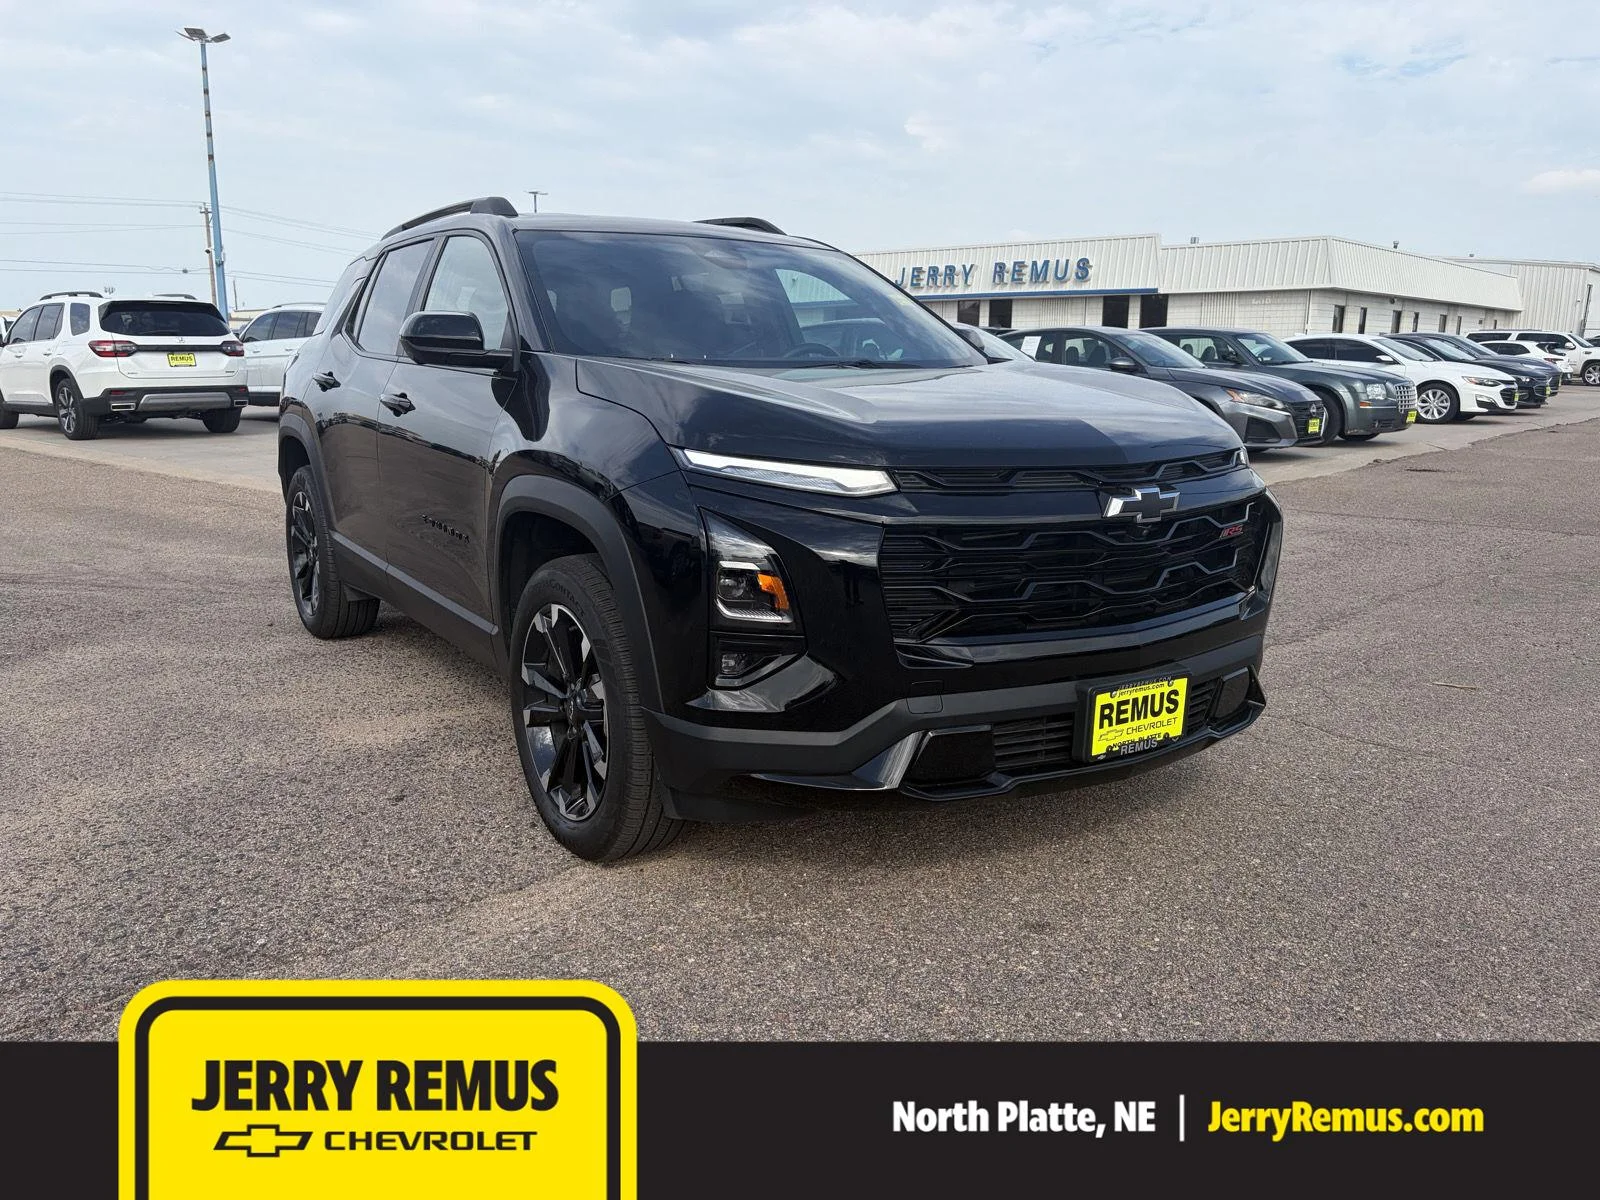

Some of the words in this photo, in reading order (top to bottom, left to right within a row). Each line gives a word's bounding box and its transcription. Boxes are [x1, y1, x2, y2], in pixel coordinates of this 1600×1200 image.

[895, 263, 974, 288] JERRY
[992, 257, 1091, 284] REMUS
[1118, 683, 1165, 698] jerryremus.com
[1098, 689, 1180, 730] REMUS
[1126, 717, 1178, 735] CHEVROLET
[1120, 738, 1158, 756] REMUS
